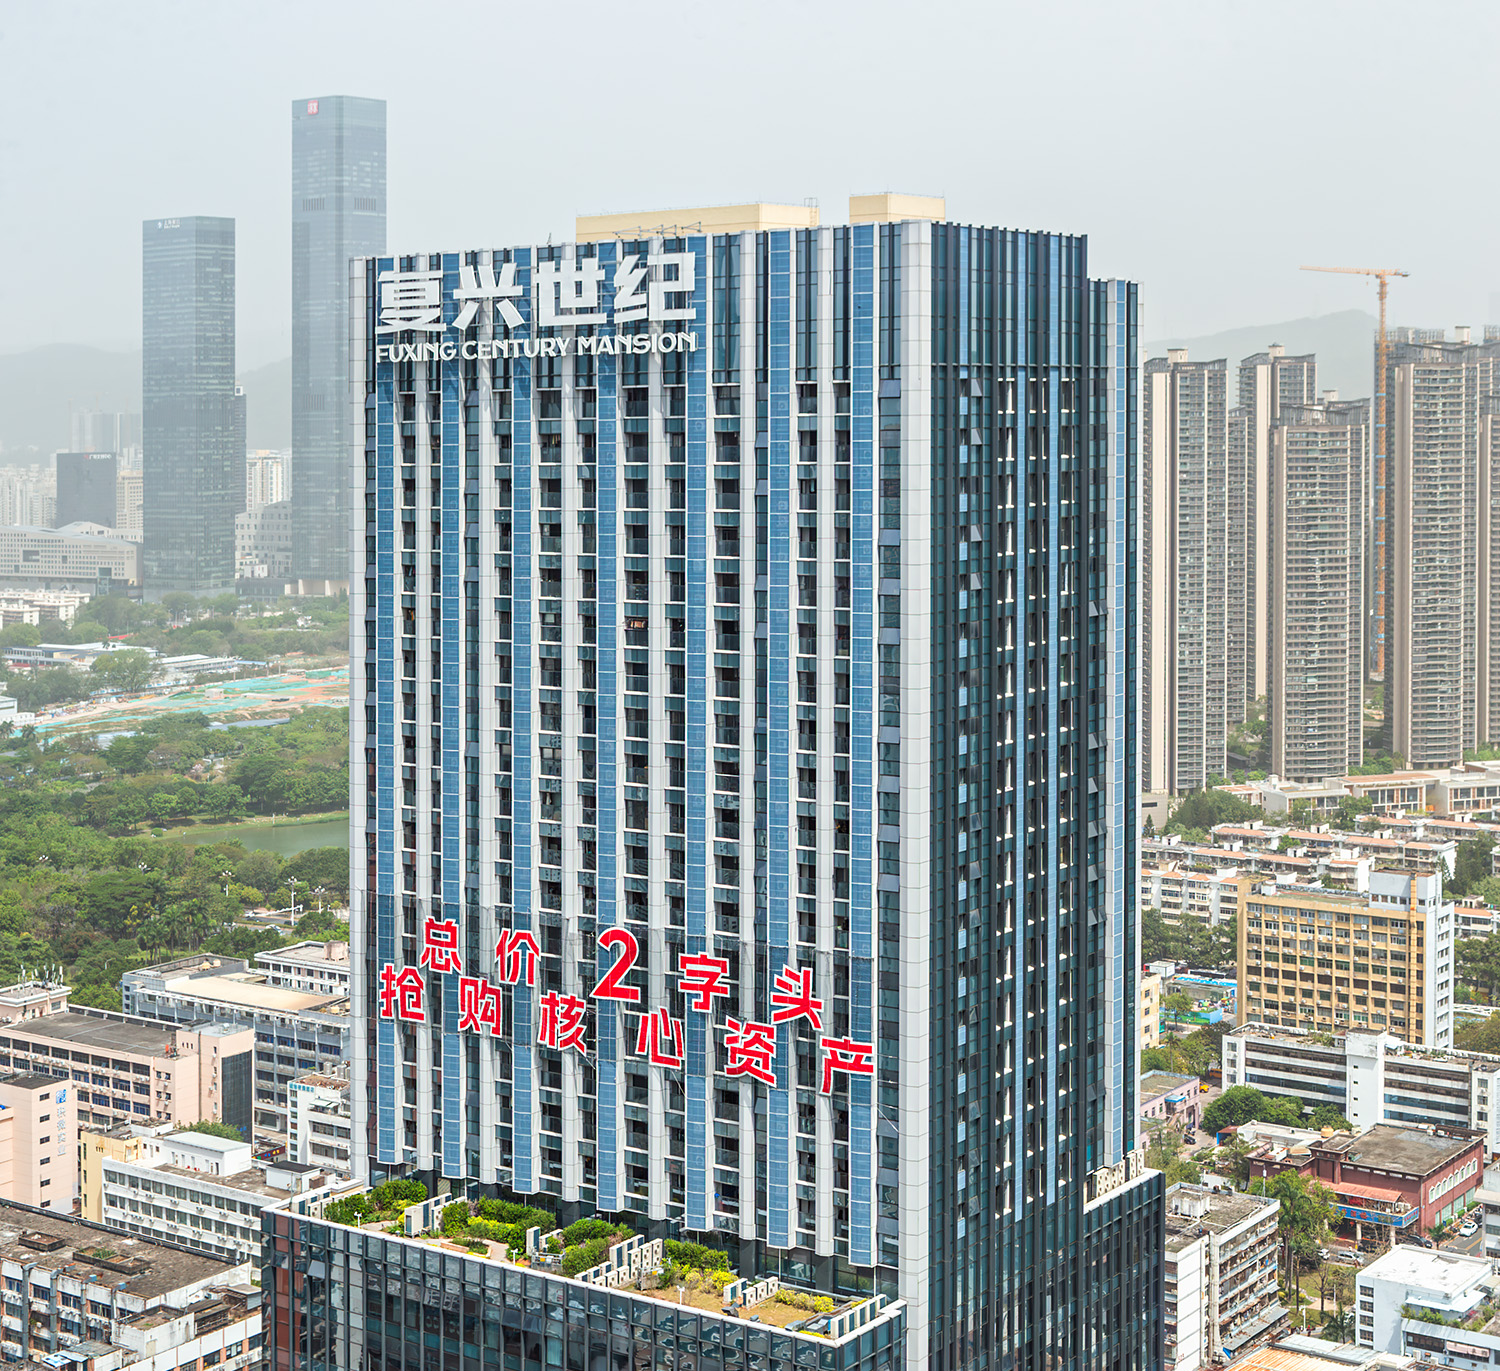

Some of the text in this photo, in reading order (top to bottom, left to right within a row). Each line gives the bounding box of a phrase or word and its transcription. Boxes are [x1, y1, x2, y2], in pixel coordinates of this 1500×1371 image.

[375, 251, 697, 335] 复兴世纪
[376, 331, 697, 363] FUXING CENTURY MANSION
[420, 917, 824, 1031] 总价2字头
[379, 962, 876, 1096] 抢购核心资产
